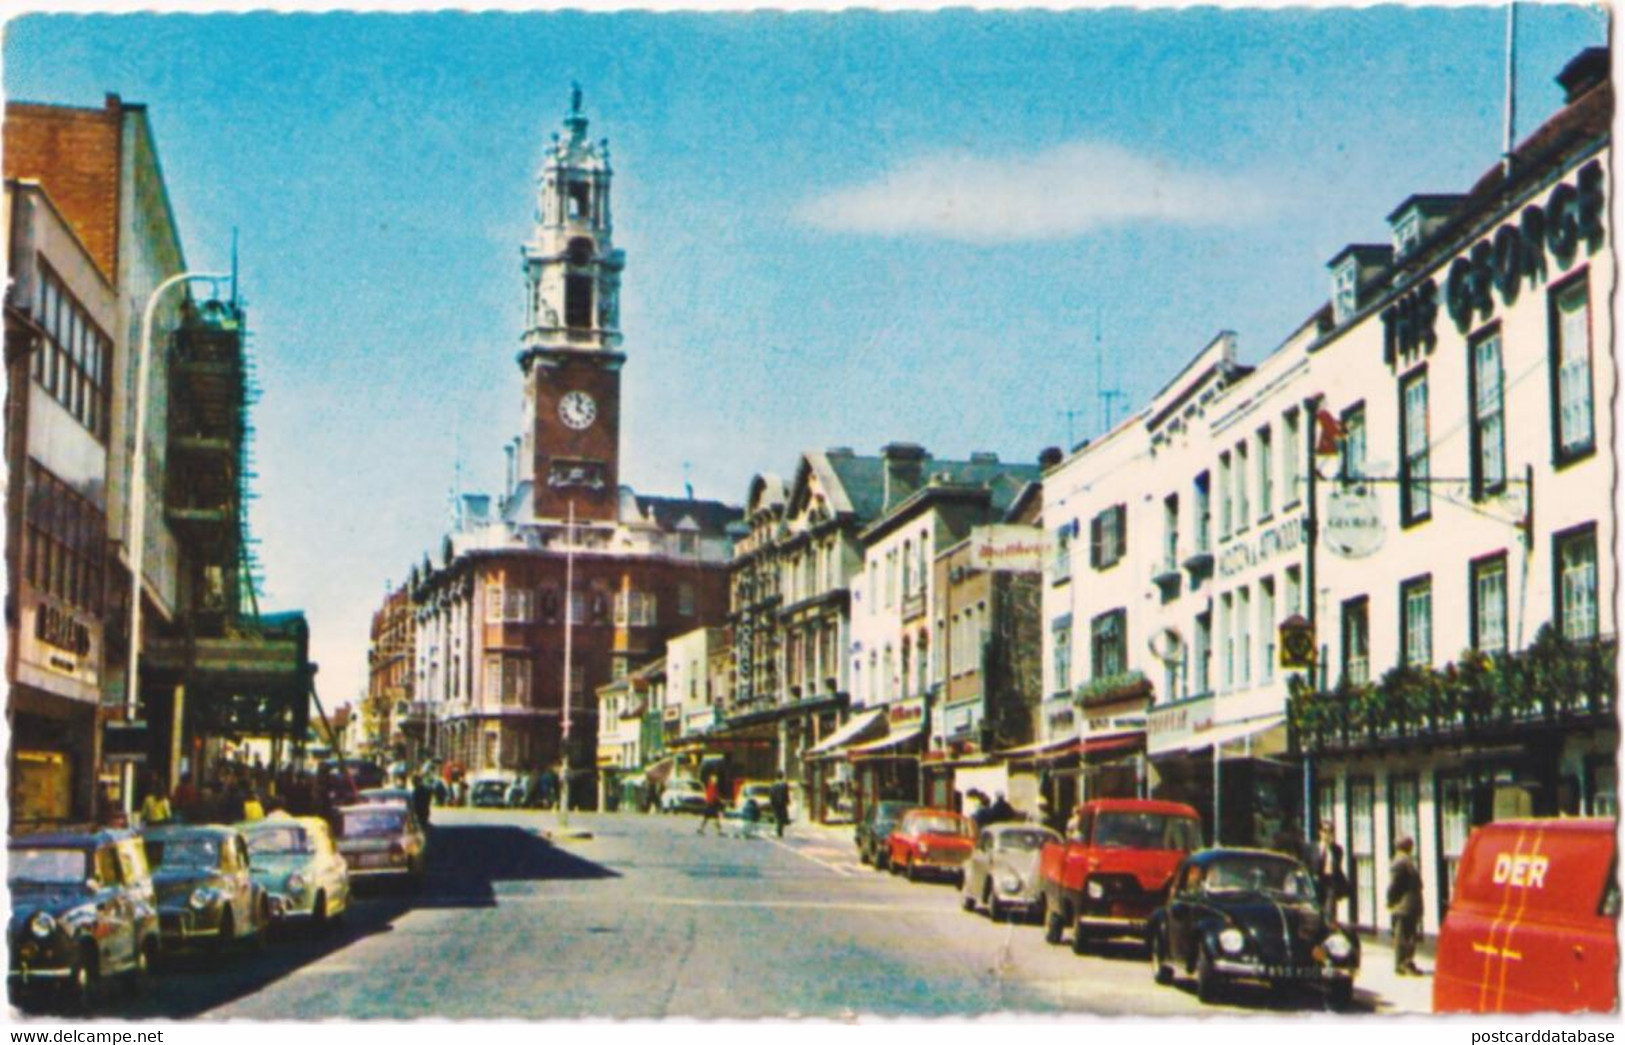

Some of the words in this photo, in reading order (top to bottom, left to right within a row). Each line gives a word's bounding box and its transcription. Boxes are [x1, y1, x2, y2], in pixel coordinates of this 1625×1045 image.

[1380, 277, 1437, 375] THE
[1447, 159, 1605, 335] GEORGE
[1493, 852, 1549, 888] DER
